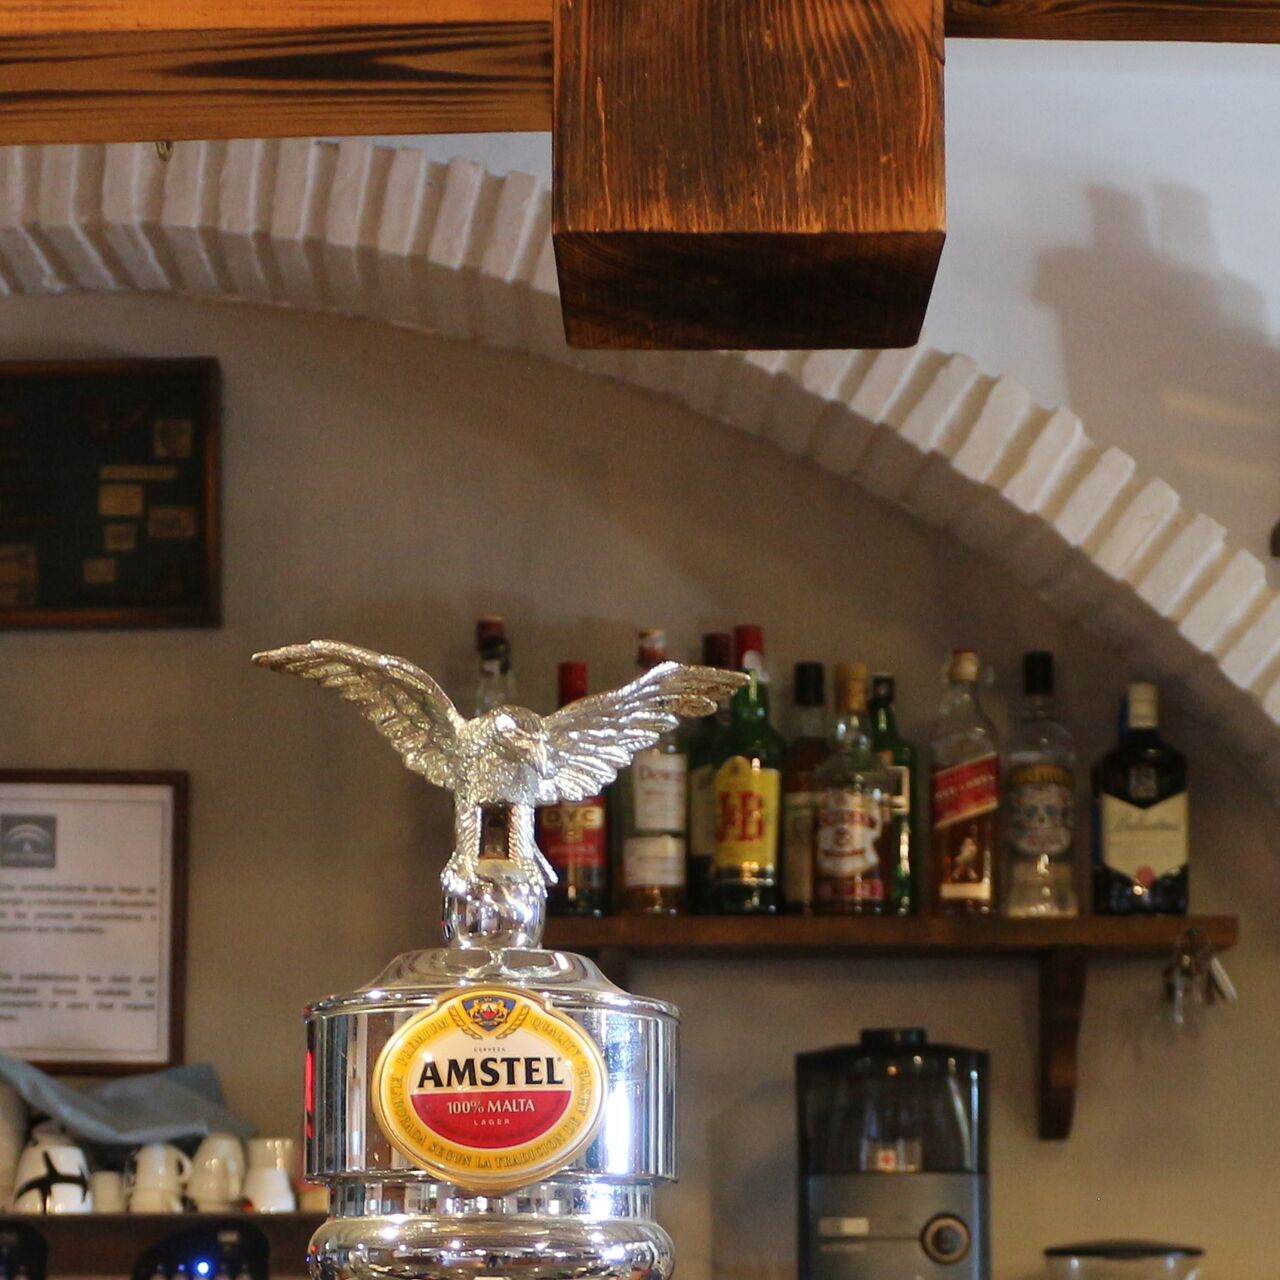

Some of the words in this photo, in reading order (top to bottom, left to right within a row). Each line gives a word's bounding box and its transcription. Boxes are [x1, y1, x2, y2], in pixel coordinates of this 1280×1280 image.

[417, 1057, 564, 1088] AMSTEL
[447, 1102, 485, 1114] 100%
[487, 1099, 535, 1113] MALTA
[473, 1118, 510, 1126] LAGER
